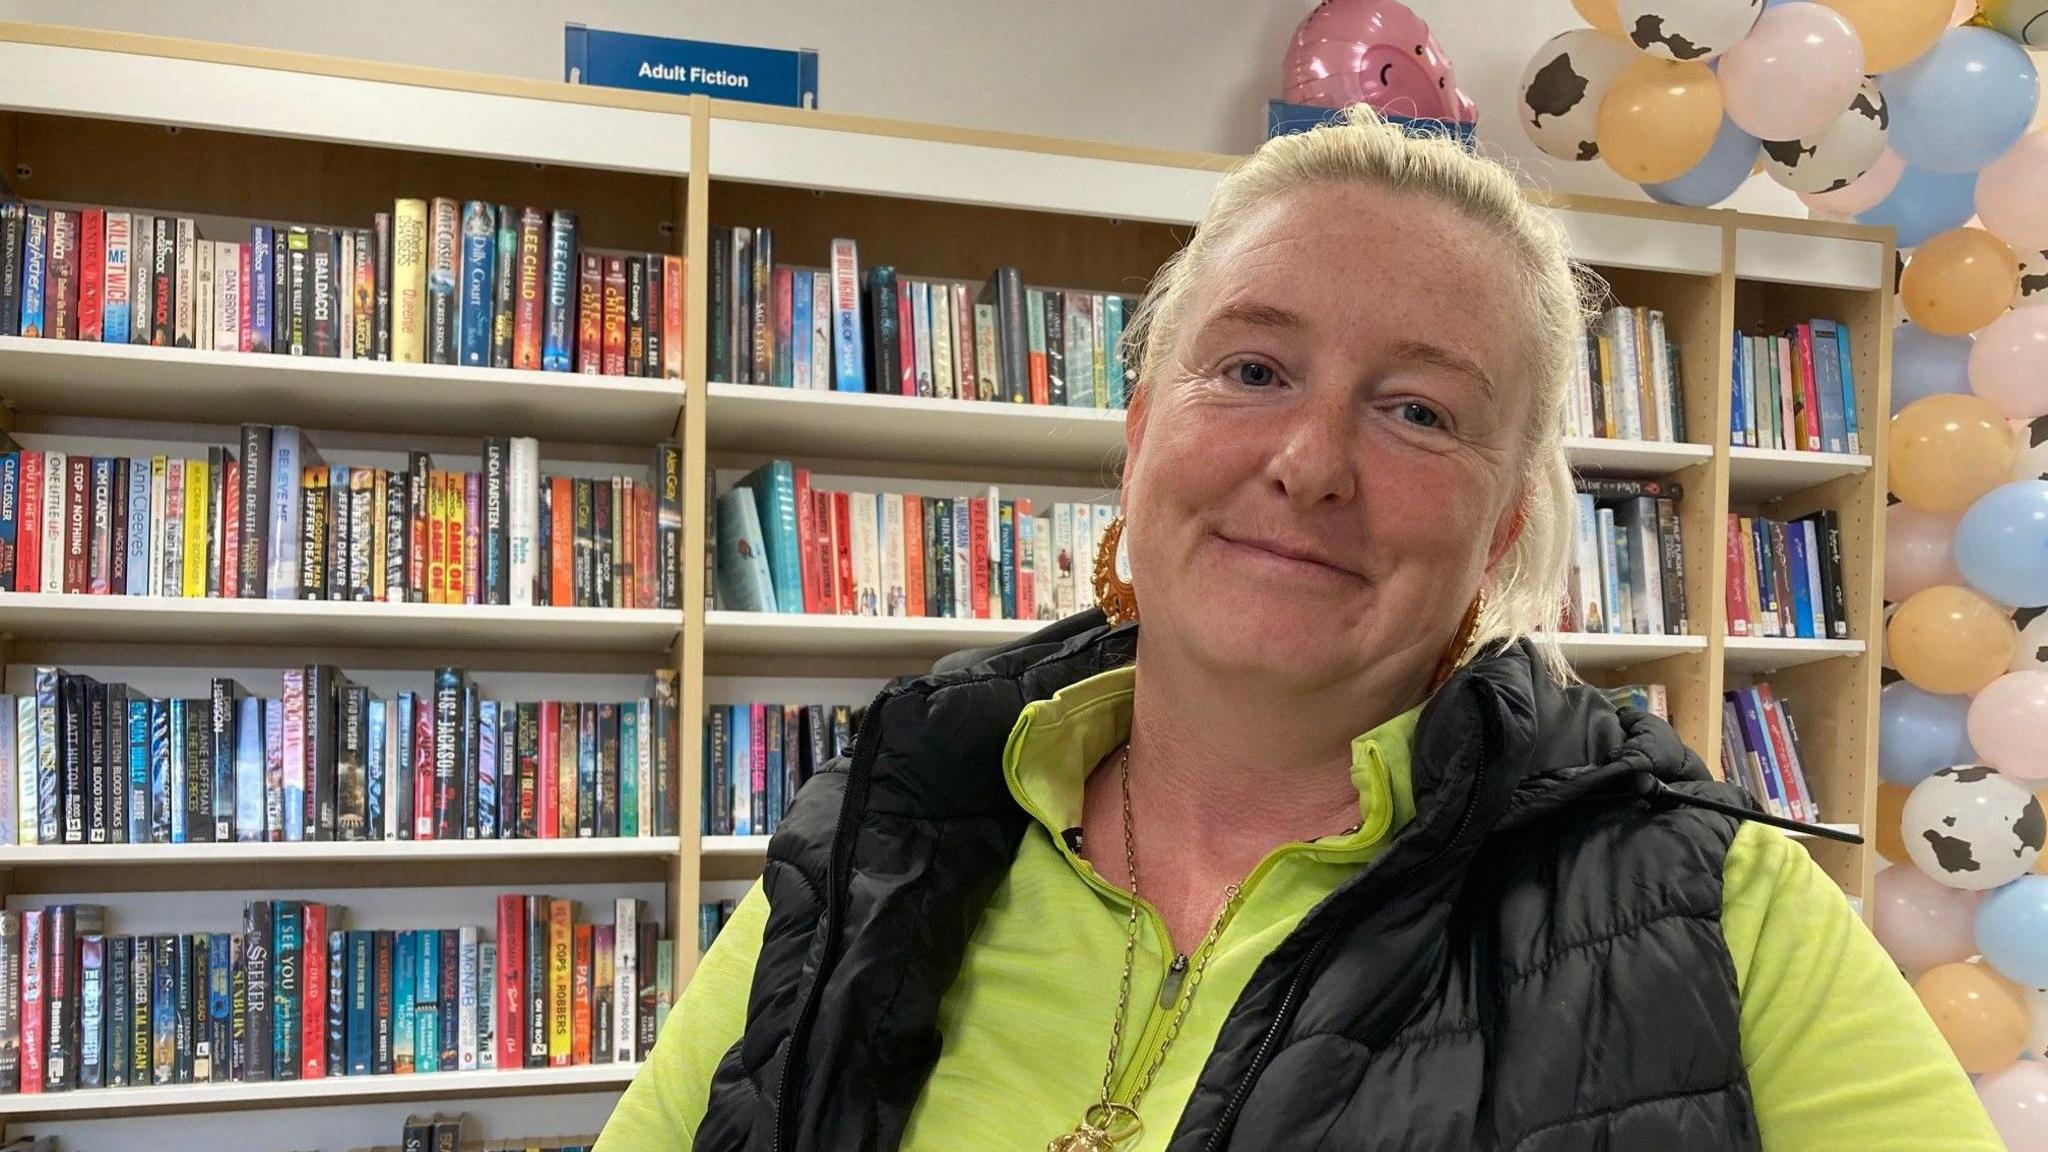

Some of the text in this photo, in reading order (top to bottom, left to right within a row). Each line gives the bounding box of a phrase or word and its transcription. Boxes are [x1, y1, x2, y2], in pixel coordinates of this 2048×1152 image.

[638, 62, 749, 88] Adult Fiction
[28, 215, 46, 250] Jeffrey
[54, 212, 64, 259] BALDACCI
[109, 220, 127, 248] KILL
[29, 250, 43, 290] Archer
[86, 216, 97, 330] SANDRA BROWN
[109, 250, 127, 263] ME
[156, 220, 168, 325] BRIDGESTOCK PAYBACK
[357, 237, 365, 285] LIE MAKER
[470, 237, 485, 305] Dilly Court
[523, 226, 536, 299] LEE CHILD
[552, 231, 567, 306] LEE CHILD
[107, 265, 127, 305] TWICE
[137, 267, 146, 329] CONSEQUENCES
[226, 270, 236, 332] DAN BROWN
[257, 274, 265, 301] WHITE
[294, 290, 303, 315] VALLEY
[315, 258, 328, 320] BALDACCI
[583, 284, 591, 325] CHILD
[592, 293, 600, 319] LEE
[606, 287, 616, 330] CHILD
[631, 285, 640, 321] Cavanagh
[837, 259, 855, 342] BILLINGHAM DIE OF
[402, 289, 417, 334] Queenie
[616, 296, 625, 323] LEE
[756, 302, 765, 361] SAGE'S EYES
[357, 315, 365, 354] BARCLAY
[74, 463, 83, 490] STOP
[97, 460, 107, 484] TOM
[247, 443, 257, 491] CAPITOL
[277, 449, 290, 521] BELIEVE ME
[489, 446, 499, 477] LINDA
[666, 450, 677, 501] Alex Gray
[3, 459, 13, 520] CLIVE CUSSLER
[25, 458, 35, 530] YOU LET ME IN
[49, 457, 60, 537] ONE LITTLE LIE
[96, 486, 107, 529] CLANCY
[132, 463, 147, 557] Ann Cleeves
[246, 494, 256, 532] DEATH
[315, 491, 323, 509] THE
[578, 484, 588, 528] Alex Gray
[72, 505, 82, 554] NOTHING
[305, 491, 314, 587] JEFFERY DEAVER
[337, 491, 347, 585] JEFFERY DEAVER
[942, 518, 951, 574] BIRDCAGE
[957, 506, 967, 548] HANGMAN
[973, 503, 986, 588] PETER CAREY
[1002, 527, 1010, 552] need
[4, 545, 13, 571] FINAL
[352, 545, 360, 588] DEAVER
[433, 521, 443, 589] GAME ON
[450, 522, 461, 590] GAME ON
[1003, 555, 1010, 565] to
[214, 685, 223, 732] HEWSON
[307, 698, 315, 736] HEWSON
[520, 710, 528, 749] JACKSON
[811, 708, 820, 738] Lynda La
[67, 713, 79, 790] MATT HILTON
[348, 717, 357, 750] HEWSON
[436, 720, 455, 777] JACKSON
[93, 701, 101, 828] MATT HILTON BLOOD TRACKS
[112, 701, 122, 827] MATT HILTON BLOOD TRACKS
[189, 712, 197, 811] ALL THE LITTLE PIECES
[199, 710, 208, 815] JILLIANE HOFFMAN
[604, 779, 614, 814] KEANE
[158, 939, 172, 966] Map
[283, 925, 294, 950] SEE
[115, 941, 123, 1021] SHE LIES IN WAIT
[247, 943, 266, 1012] SEEKER
[282, 956, 294, 989] YOU
[310, 968, 318, 998] DEAD
[556, 943, 566, 1034] COPS ROBBERS
[51, 1001, 61, 1041] Damien
[84, 981, 99, 1064] NEMESIS MANIFESTO
[136, 941, 147, 1068] THE MOTHER T.M. LOGAN
[233, 970, 244, 1038] SUNBURN
[576, 966, 588, 1041] PAST LIFE
[621, 976, 630, 1041] SLEEPING DOGS
